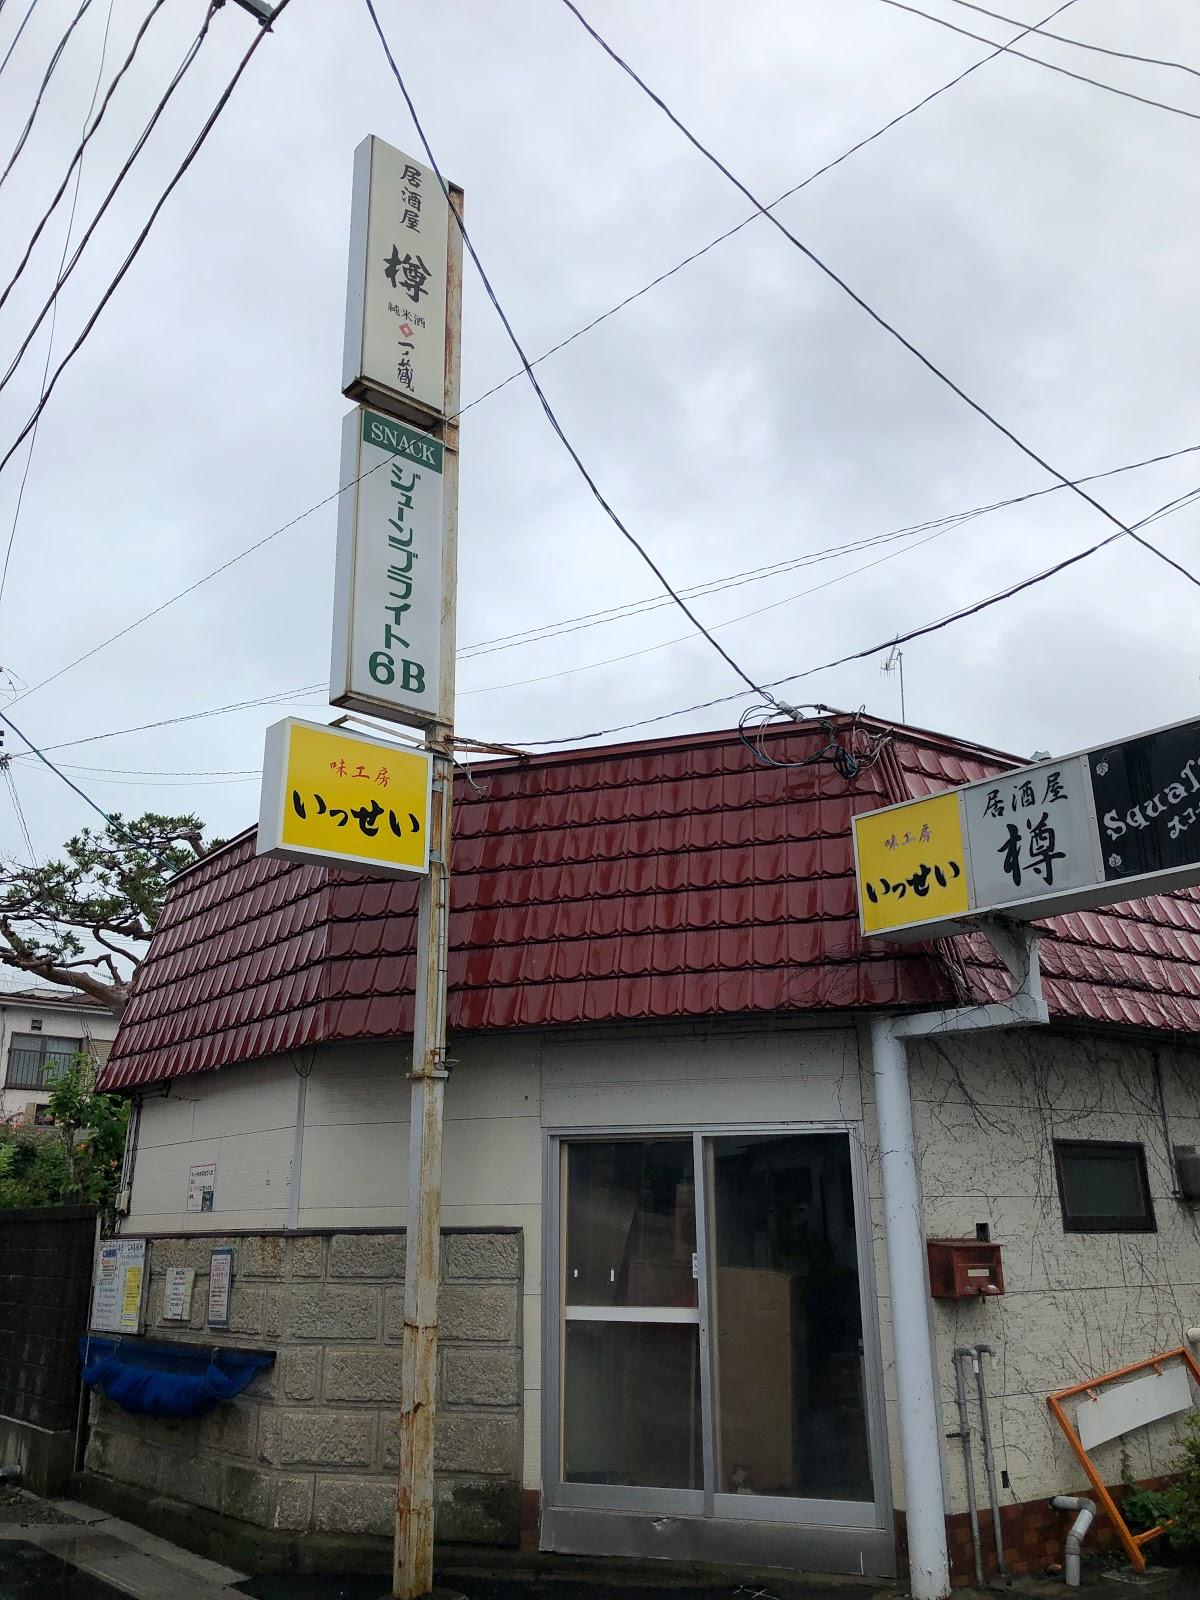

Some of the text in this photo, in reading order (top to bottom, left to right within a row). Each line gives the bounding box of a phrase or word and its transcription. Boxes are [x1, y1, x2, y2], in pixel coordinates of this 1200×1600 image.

[400, 164, 423, 234] 居酒屋
[383, 243, 432, 303] 樽
[387, 301, 426, 329] 純米酒
[371, 421, 436, 465] SNACK
[368, 651, 426, 693] 6B
[329, 758, 390, 787] 味工房
[292, 790, 420, 838] いっせい
[982, 772, 1068, 818] 居酒屋
[884, 823, 932, 851] 味工房
[1167, 801, 1200, 839] スコ
[997, 812, 1066, 887] 樽
[866, 861, 960, 903] いっせい
